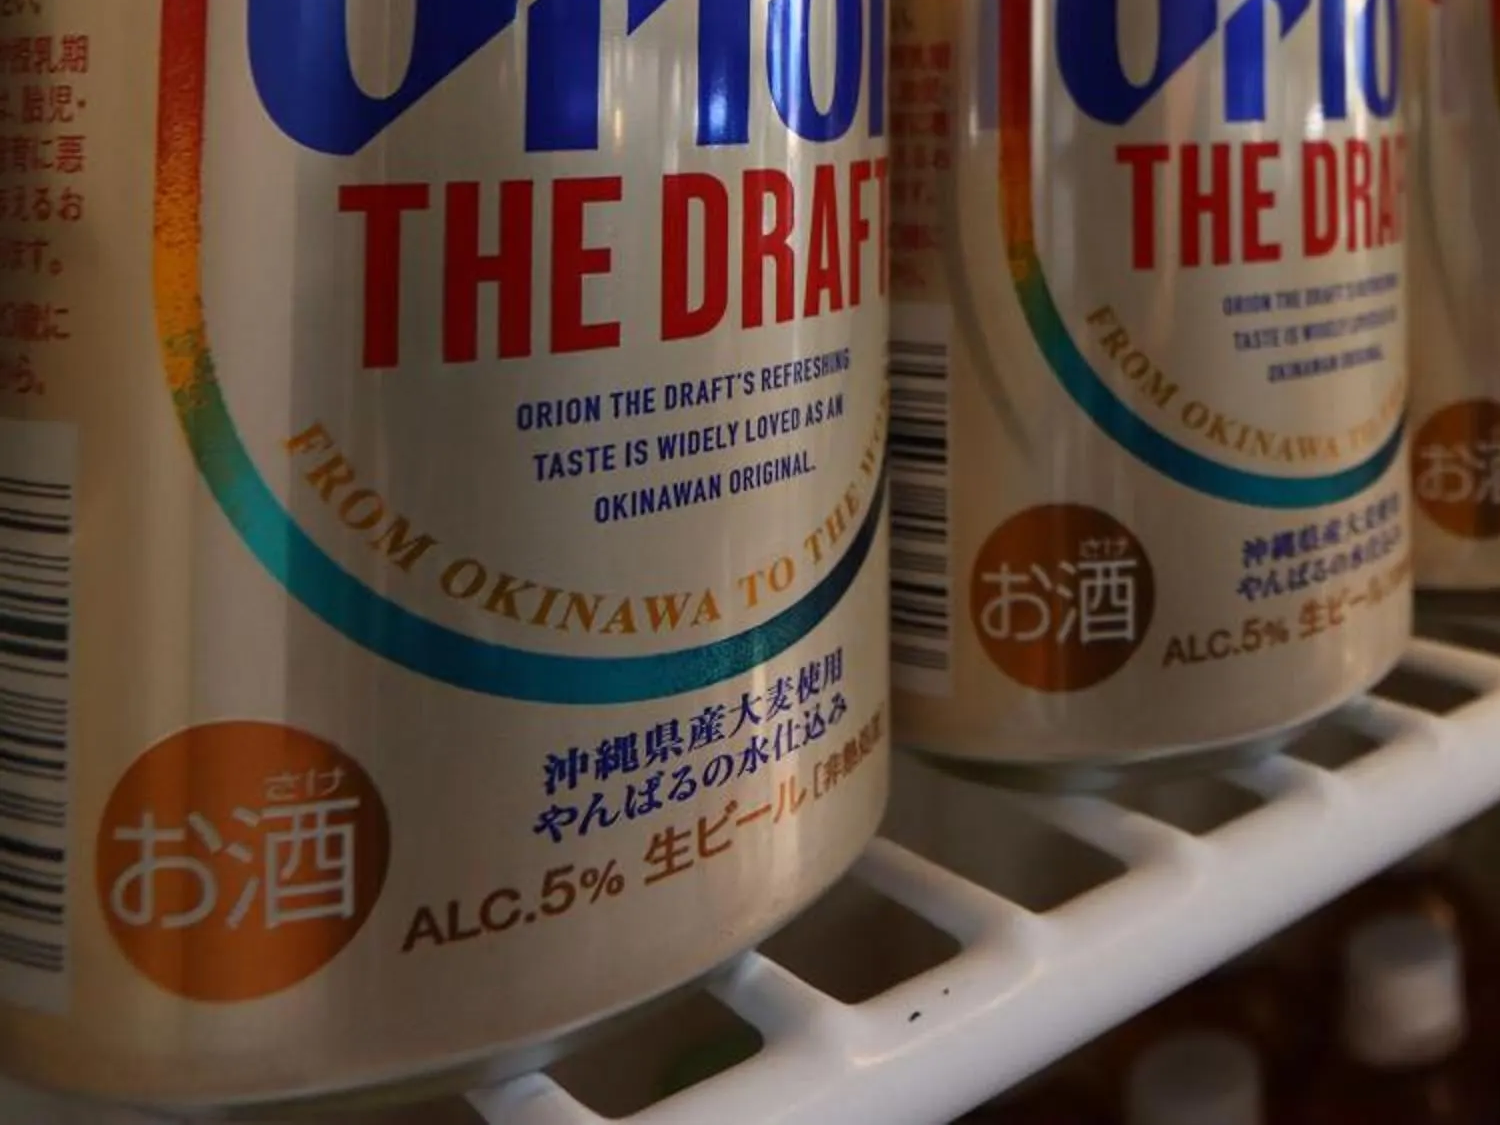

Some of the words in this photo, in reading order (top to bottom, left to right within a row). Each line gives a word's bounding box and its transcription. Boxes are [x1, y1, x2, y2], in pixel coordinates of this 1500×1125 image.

[1116, 141, 1282, 270] THE
[338, 176, 622, 369] THE
[517, 394, 601, 431] ORION
[610, 387, 656, 419] THE
[664, 371, 755, 411] DRAFT'S
[761, 348, 850, 392] REFRESHING
[1085, 304, 1179, 409] FROM
[1180, 400, 1339, 463] OKINAWA
[533, 443, 616, 482] TASTE
[625, 438, 649, 469] IS
[657, 421, 739, 462] WIDELY
[745, 407, 801, 444] LOVED
[804, 401, 824, 428] AS
[826, 394, 844, 420] AN
[284, 420, 439, 571] FROM
[439, 557, 722, 636] OKINAWA
[737, 555, 796, 610] TO
[803, 480, 860, 566] THE
[594, 473, 721, 524] OKINAWAN
[729, 450, 817, 495] ORIGINAL.
[980, 558, 1138, 645] お酒
[262, 768, 345, 800] さけ
[110, 794, 361, 931] お酒
[401, 859, 625, 953] ALC.5%
